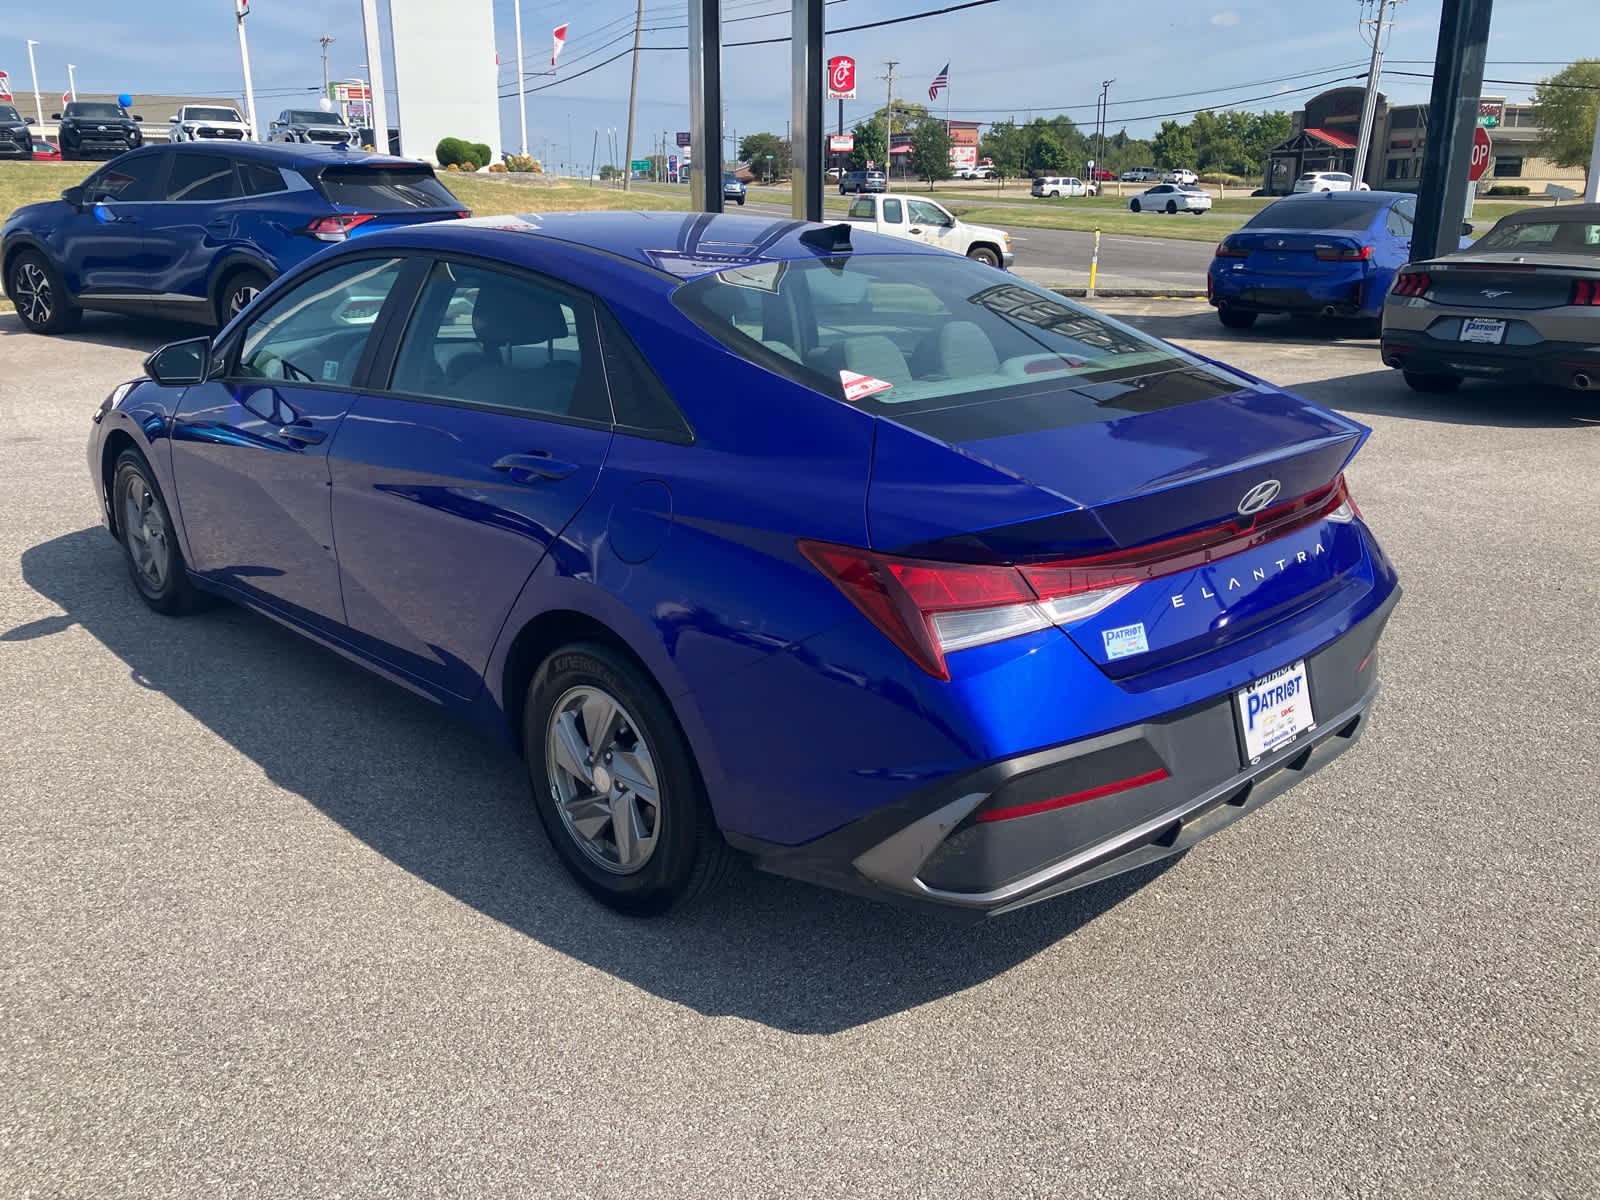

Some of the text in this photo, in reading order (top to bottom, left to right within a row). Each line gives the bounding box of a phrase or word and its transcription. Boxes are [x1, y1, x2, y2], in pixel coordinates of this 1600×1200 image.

[1471, 144, 1488, 166] OP
[1172, 544, 1325, 608] ELANTRA
[1106, 625, 1142, 647] PATRIOT
[1247, 675, 1302, 730] PATRIOT
